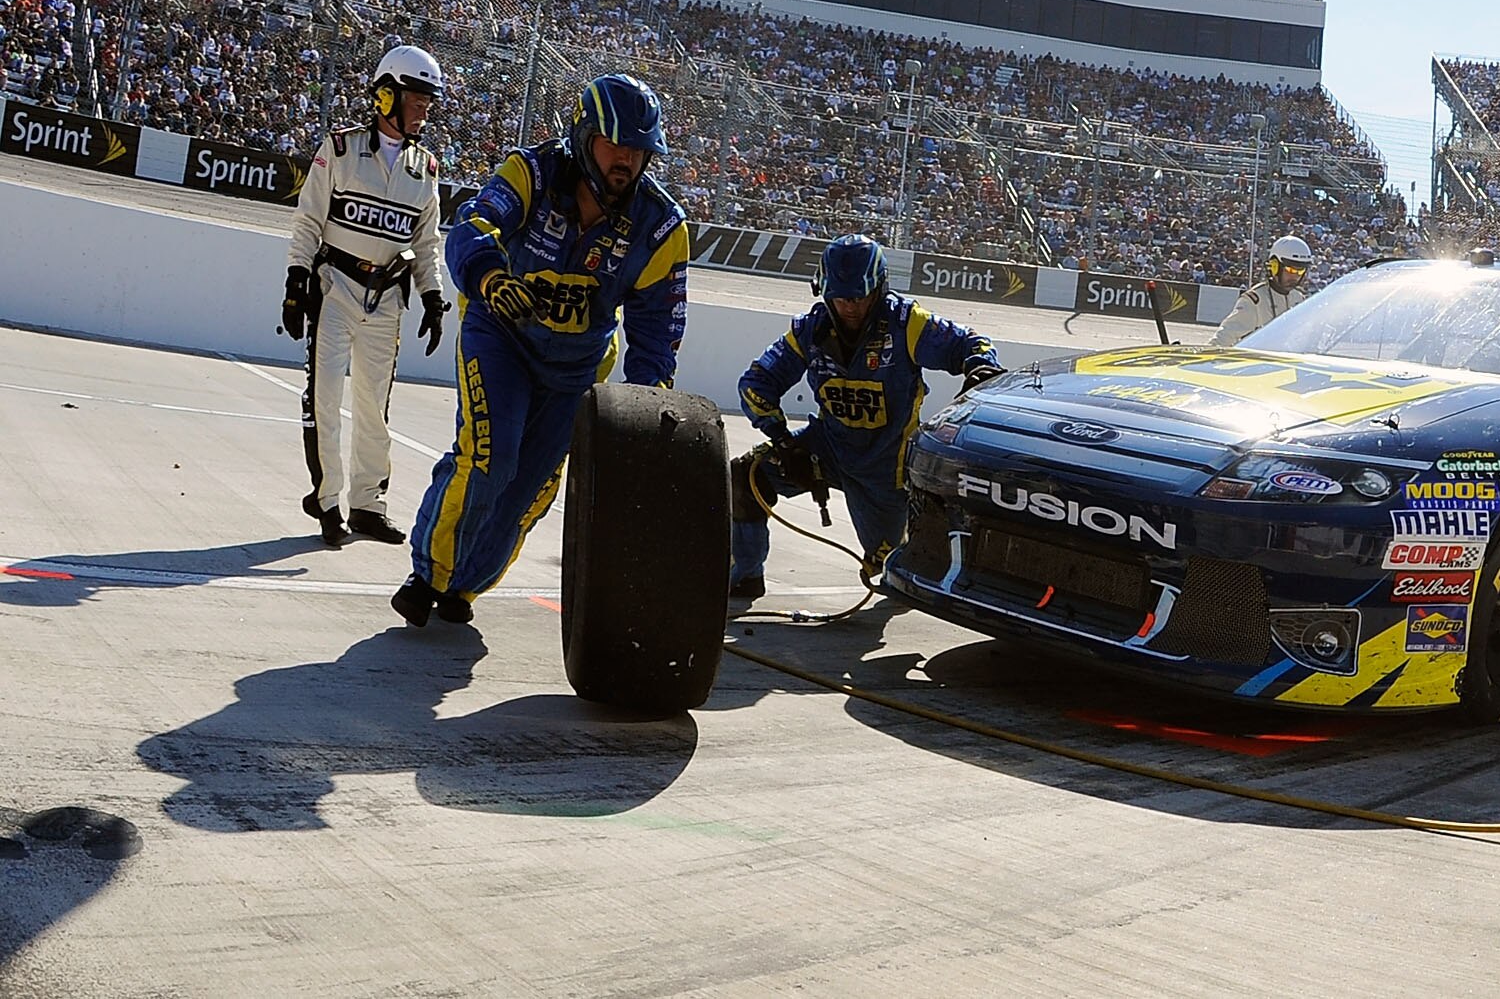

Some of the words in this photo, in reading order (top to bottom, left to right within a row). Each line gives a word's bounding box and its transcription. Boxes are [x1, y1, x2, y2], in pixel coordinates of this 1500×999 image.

[11, 111, 93, 156] Sprint
[195, 149, 278, 191] Sprint
[343, 201, 413, 234] OFFICIAL
[920, 261, 995, 293] Sprint
[467, 356, 489, 416] BEST
[824, 386, 883, 407] BEST
[831, 401, 880, 423] BUY
[1062, 421, 1109, 440] Ford
[475, 418, 491, 475] BUY
[1442, 450, 1496, 460] GOODYEAR
[1285, 475, 1335, 492] PETTY
[1405, 481, 1497, 500] MOOG
[957, 473, 1177, 551] FUSION
[1412, 500, 1459, 510] CHASSIS
[1464, 500, 1496, 510] PARTS
[1392, 510, 1489, 537] MAHLE
[1389, 544, 1464, 565] COMP
[1439, 561, 1473, 570] CAMS
[1393, 577, 1472, 596] Edelbrock
[1411, 619, 1463, 632] SUNOCO
